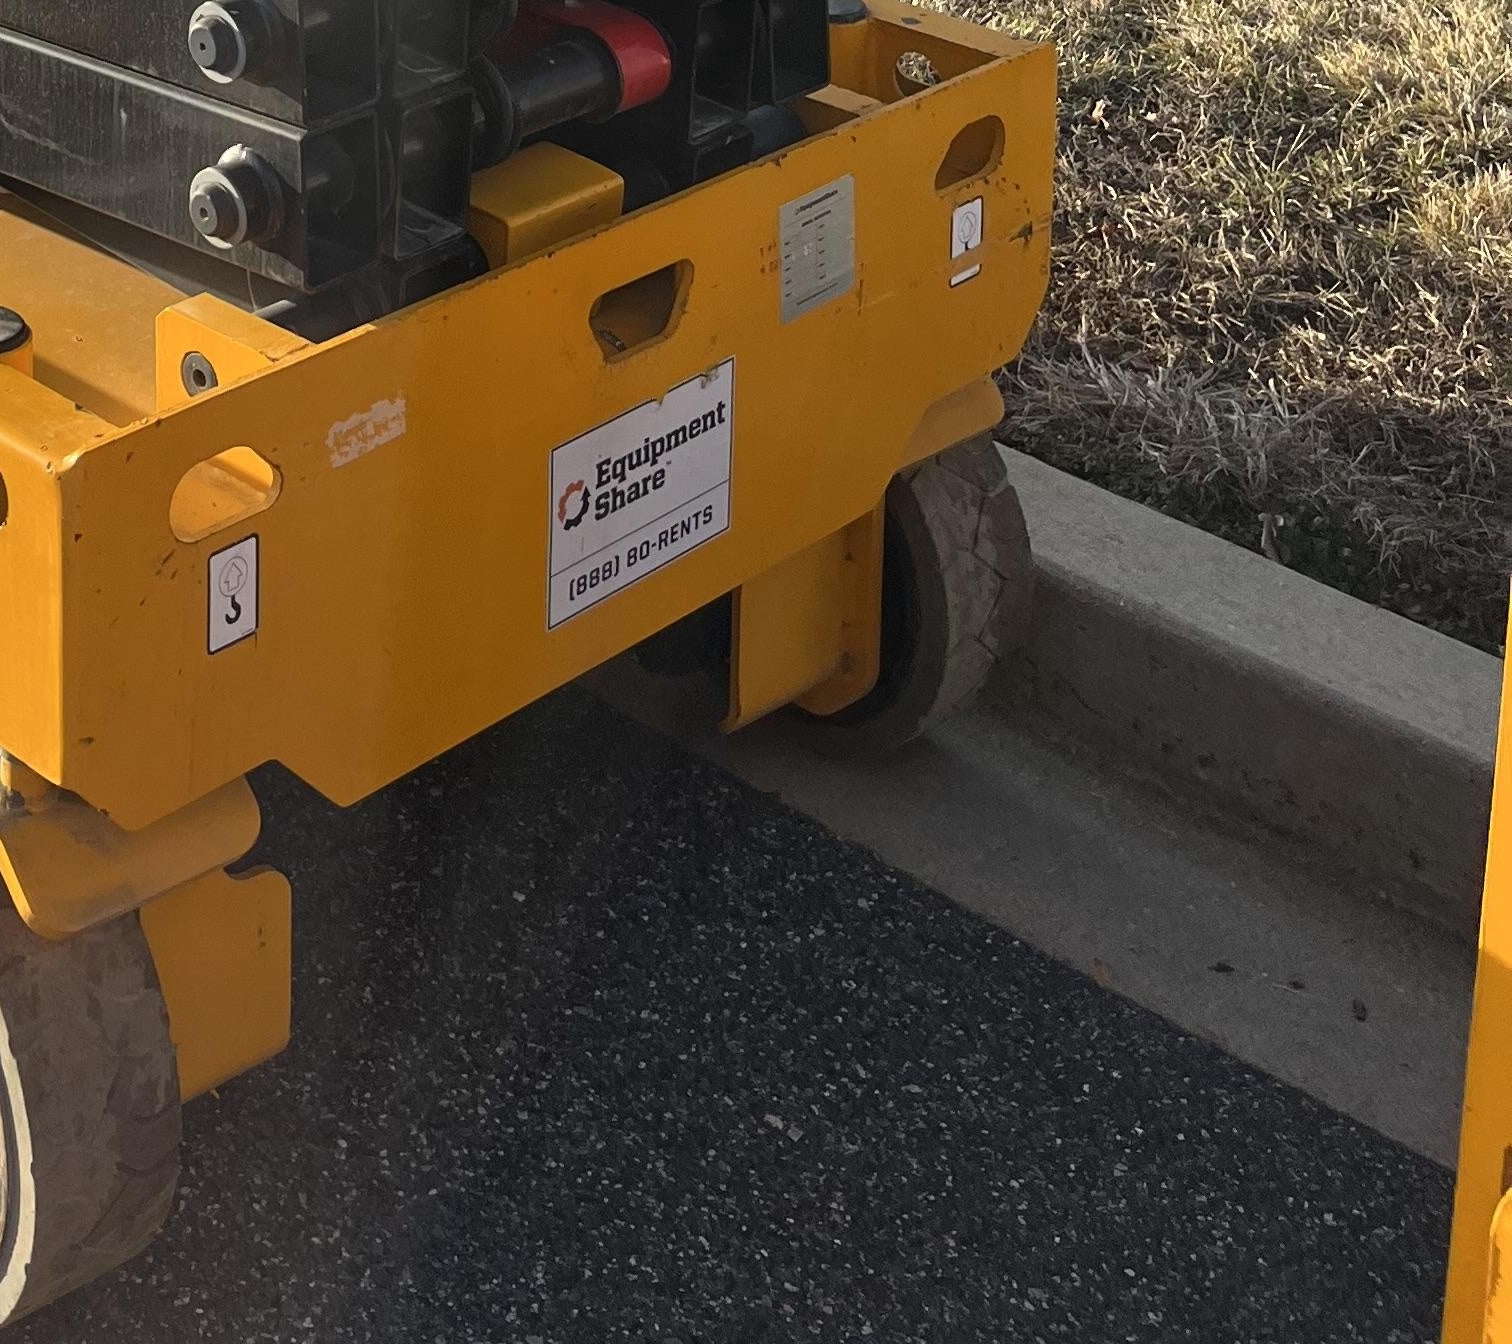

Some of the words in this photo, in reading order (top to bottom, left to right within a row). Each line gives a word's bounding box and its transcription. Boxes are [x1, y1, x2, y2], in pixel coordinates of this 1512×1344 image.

[595, 400, 726, 489] Equipment
[595, 468, 665, 521] Share
[569, 555, 620, 601] (888)
